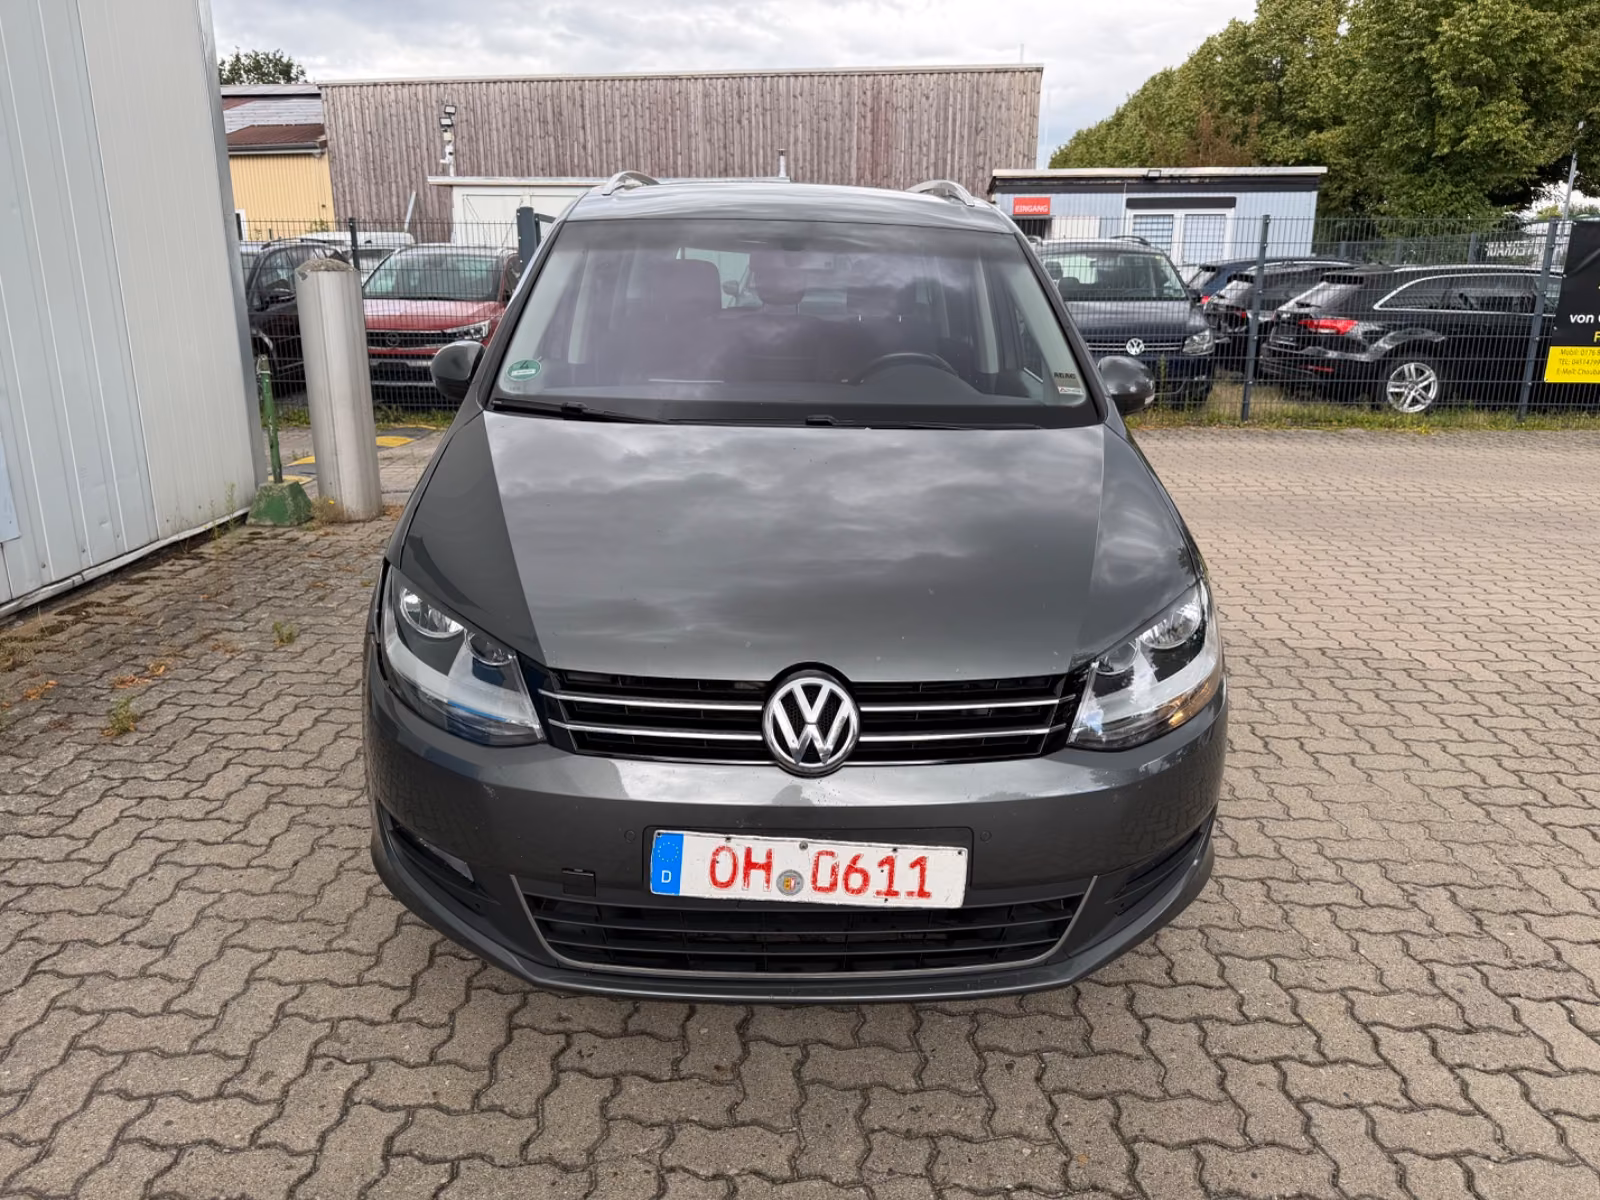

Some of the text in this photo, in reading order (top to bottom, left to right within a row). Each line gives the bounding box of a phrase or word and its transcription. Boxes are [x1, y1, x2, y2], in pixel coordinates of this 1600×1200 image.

[1015, 204, 1049, 213] EINGANG
[1569, 314, 1595, 323] von
[763, 676, 859, 769] VW
[661, 869, 672, 884] D
[709, 845, 933, 899] OH 0611
